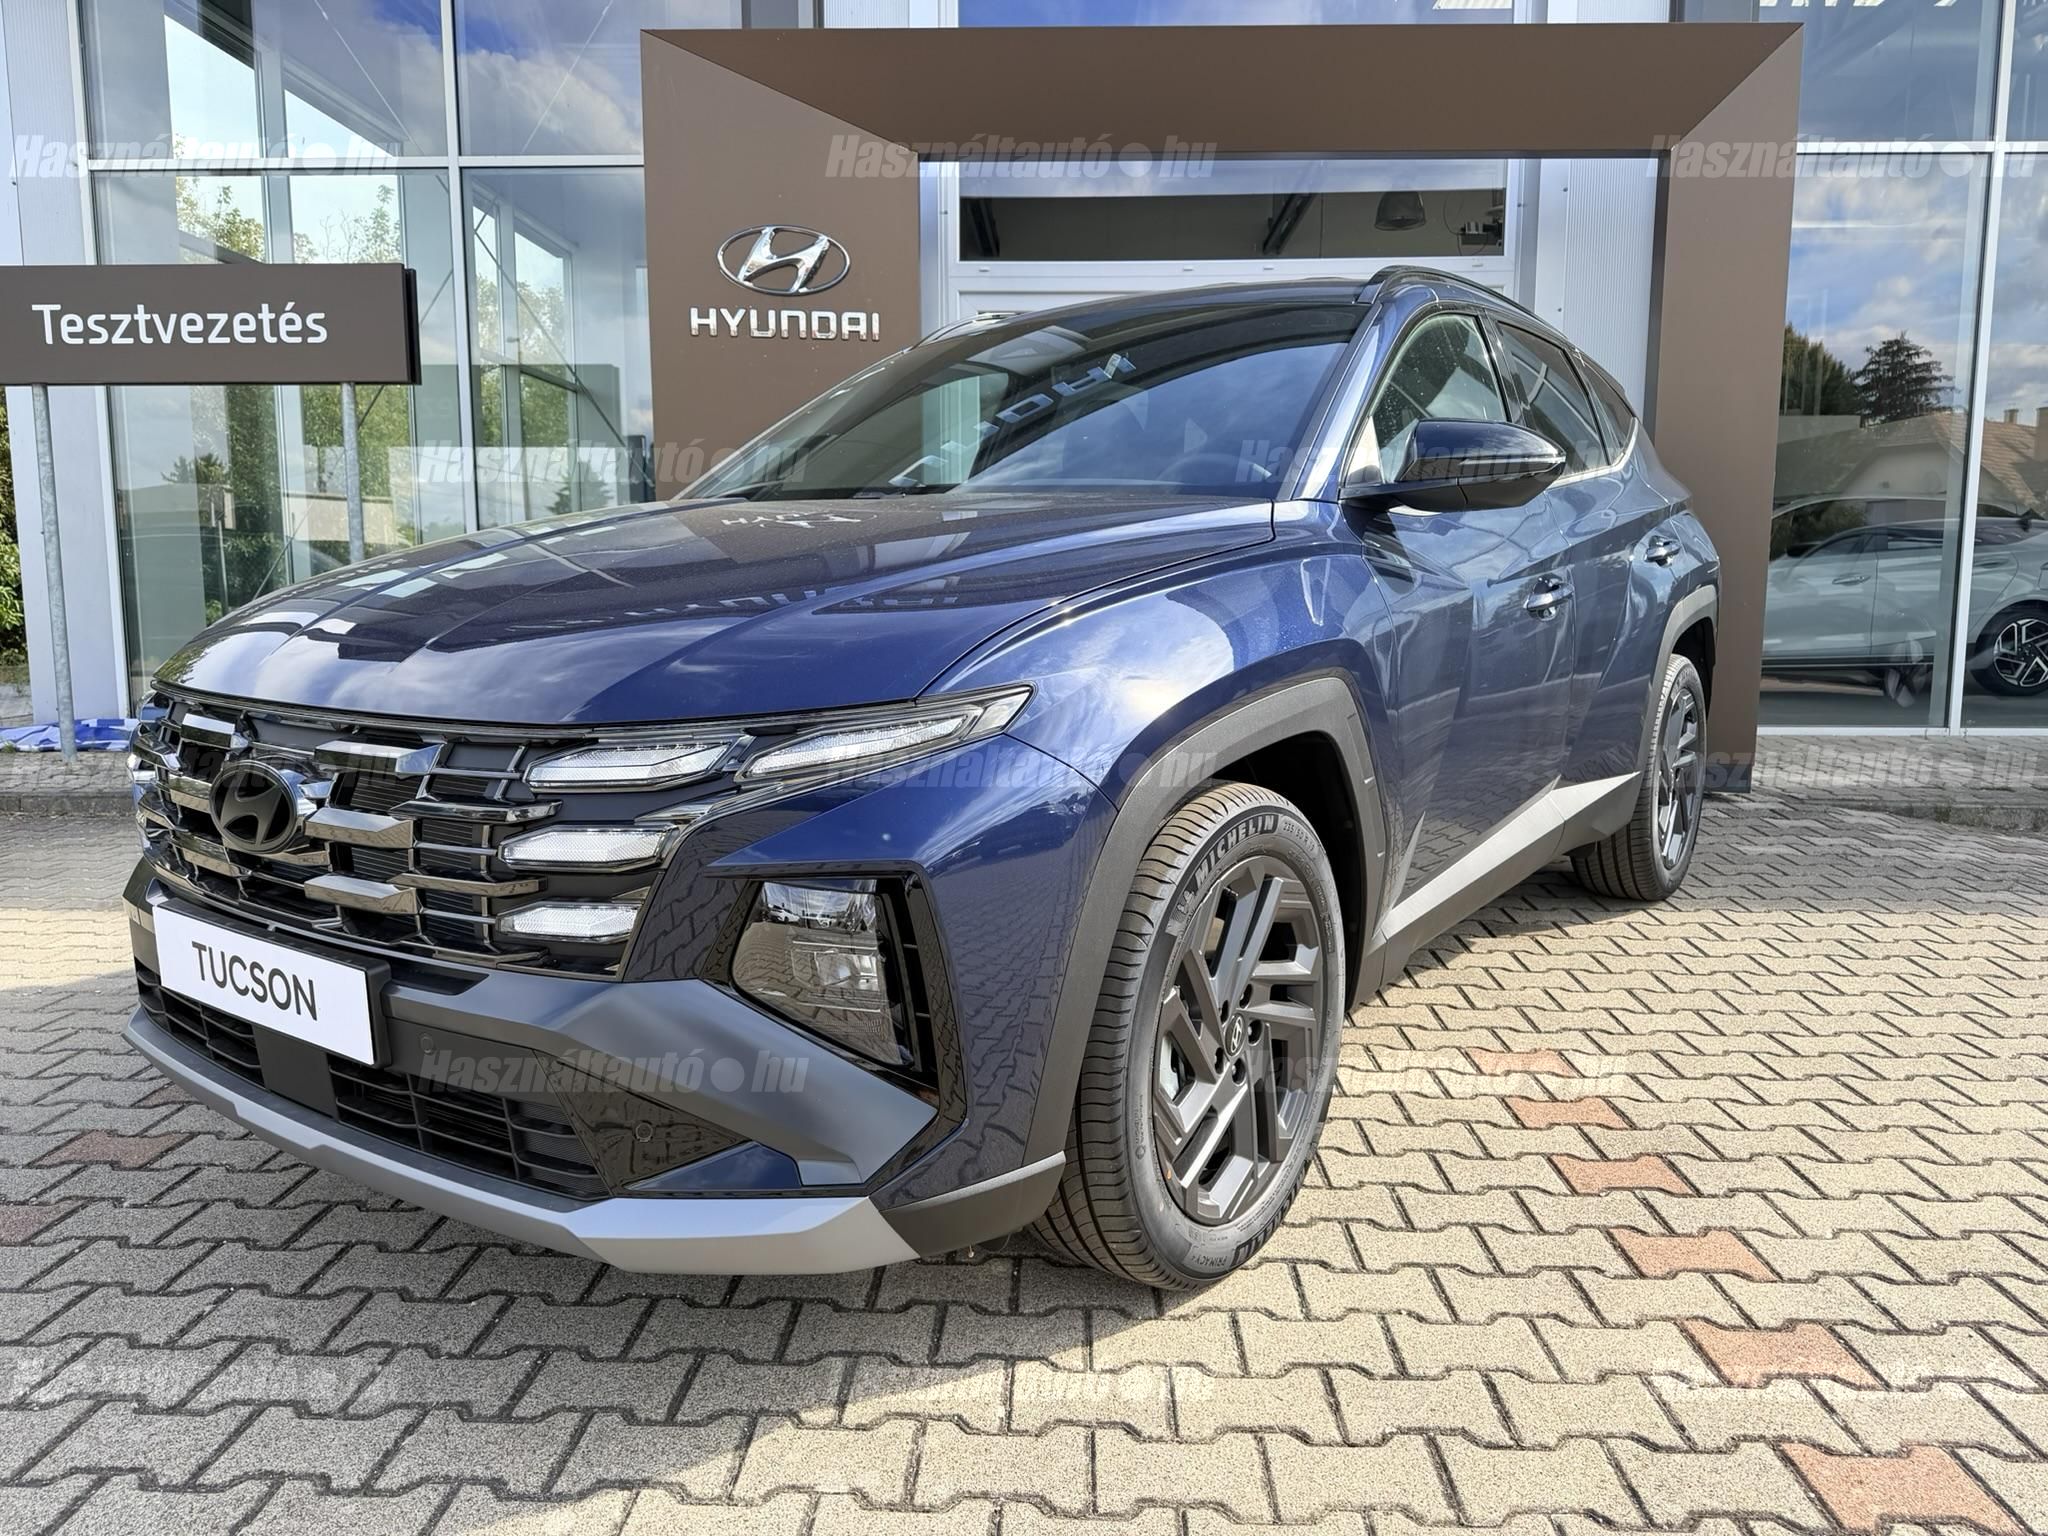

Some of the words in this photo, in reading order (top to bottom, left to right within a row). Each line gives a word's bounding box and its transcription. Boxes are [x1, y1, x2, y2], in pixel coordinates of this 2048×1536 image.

[31, 301, 328, 344] Tesztvezetés
[689, 306, 881, 341] HYUNDAI
[1194, 814, 1276, 890] MICHELIN
[190, 940, 320, 1022] TUCSON
